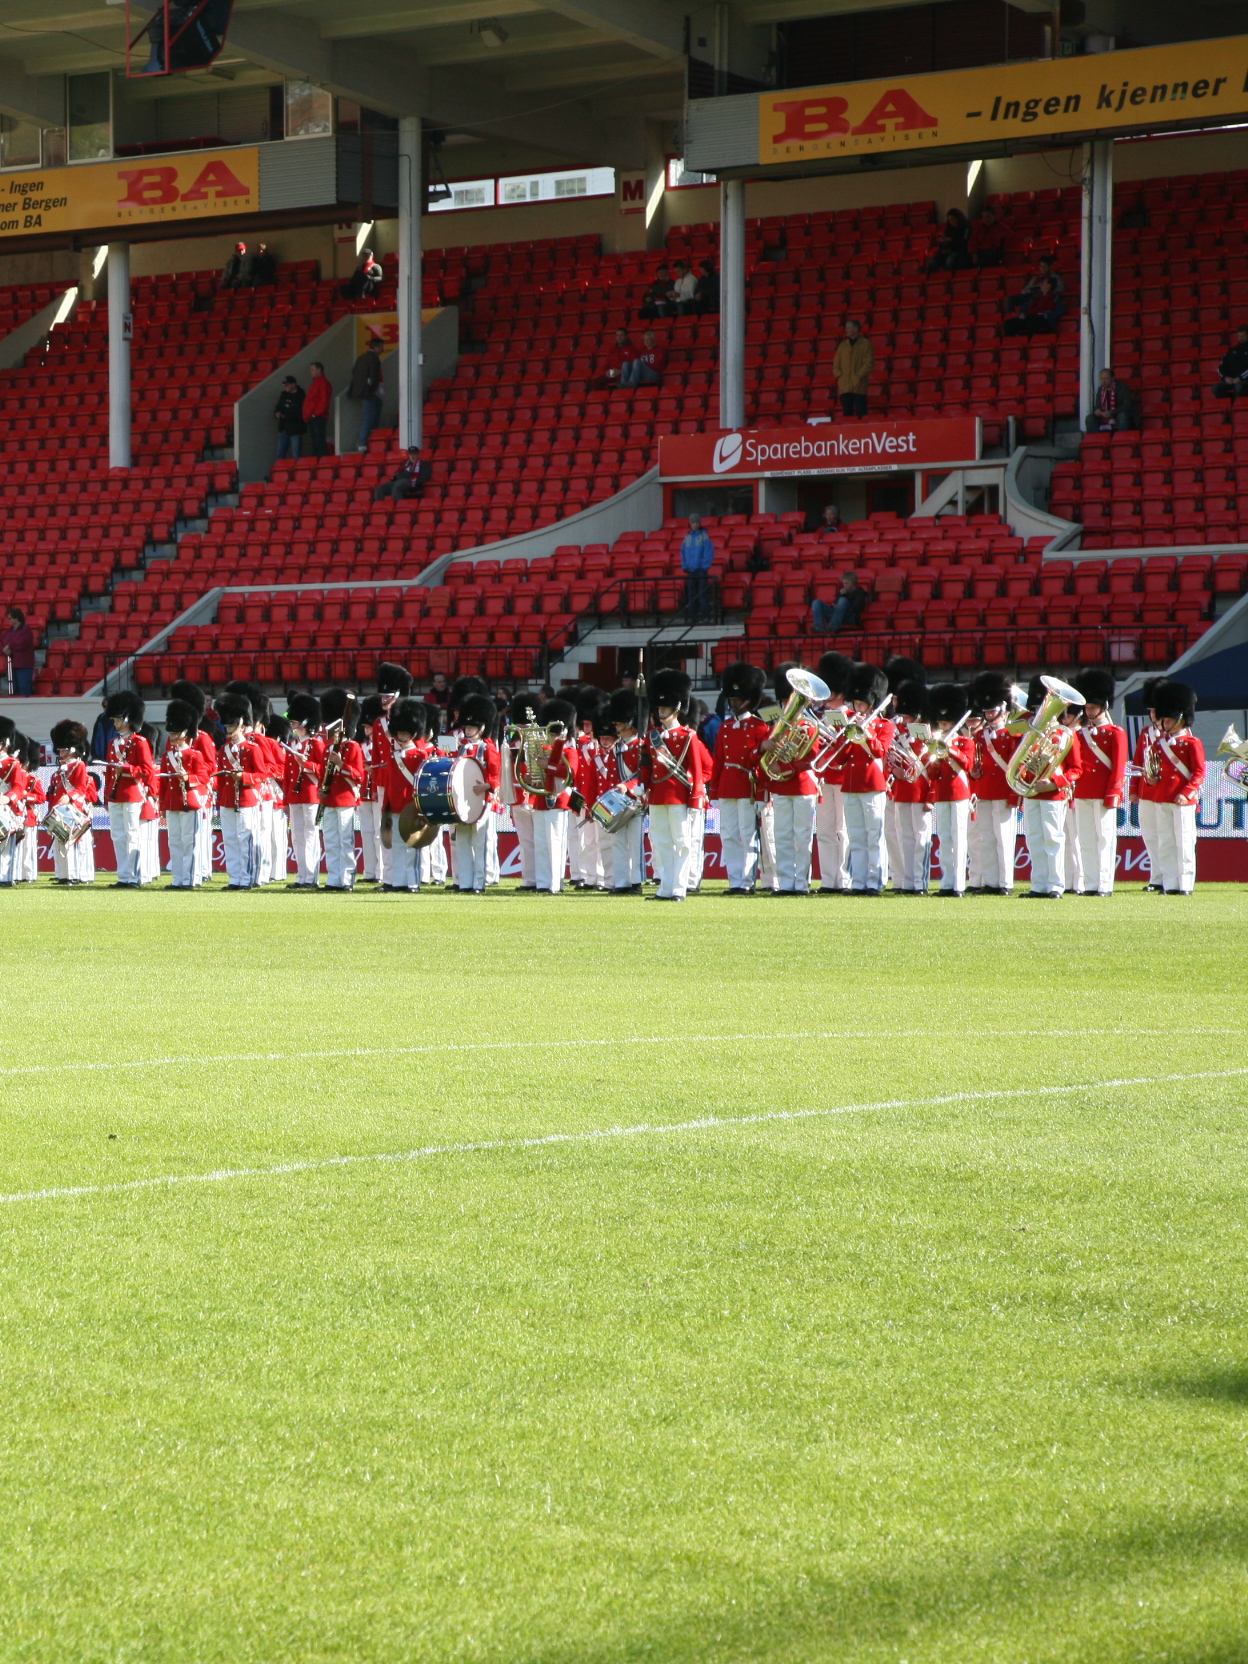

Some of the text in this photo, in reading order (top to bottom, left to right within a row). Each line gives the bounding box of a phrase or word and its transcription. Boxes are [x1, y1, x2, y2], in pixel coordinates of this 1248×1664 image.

[1096, 76, 1228, 113] kjenner
[772, 88, 939, 145] BA
[9, 181, 44, 196] Ingen
[117, 160, 251, 209] BA
[622, 179, 645, 202] M
[22, 197, 68, 212] Bergen
[23, 214, 43, 229] BA
[124, 321, 132, 333] N
[745, 432, 917, 465] SparebankenVest
